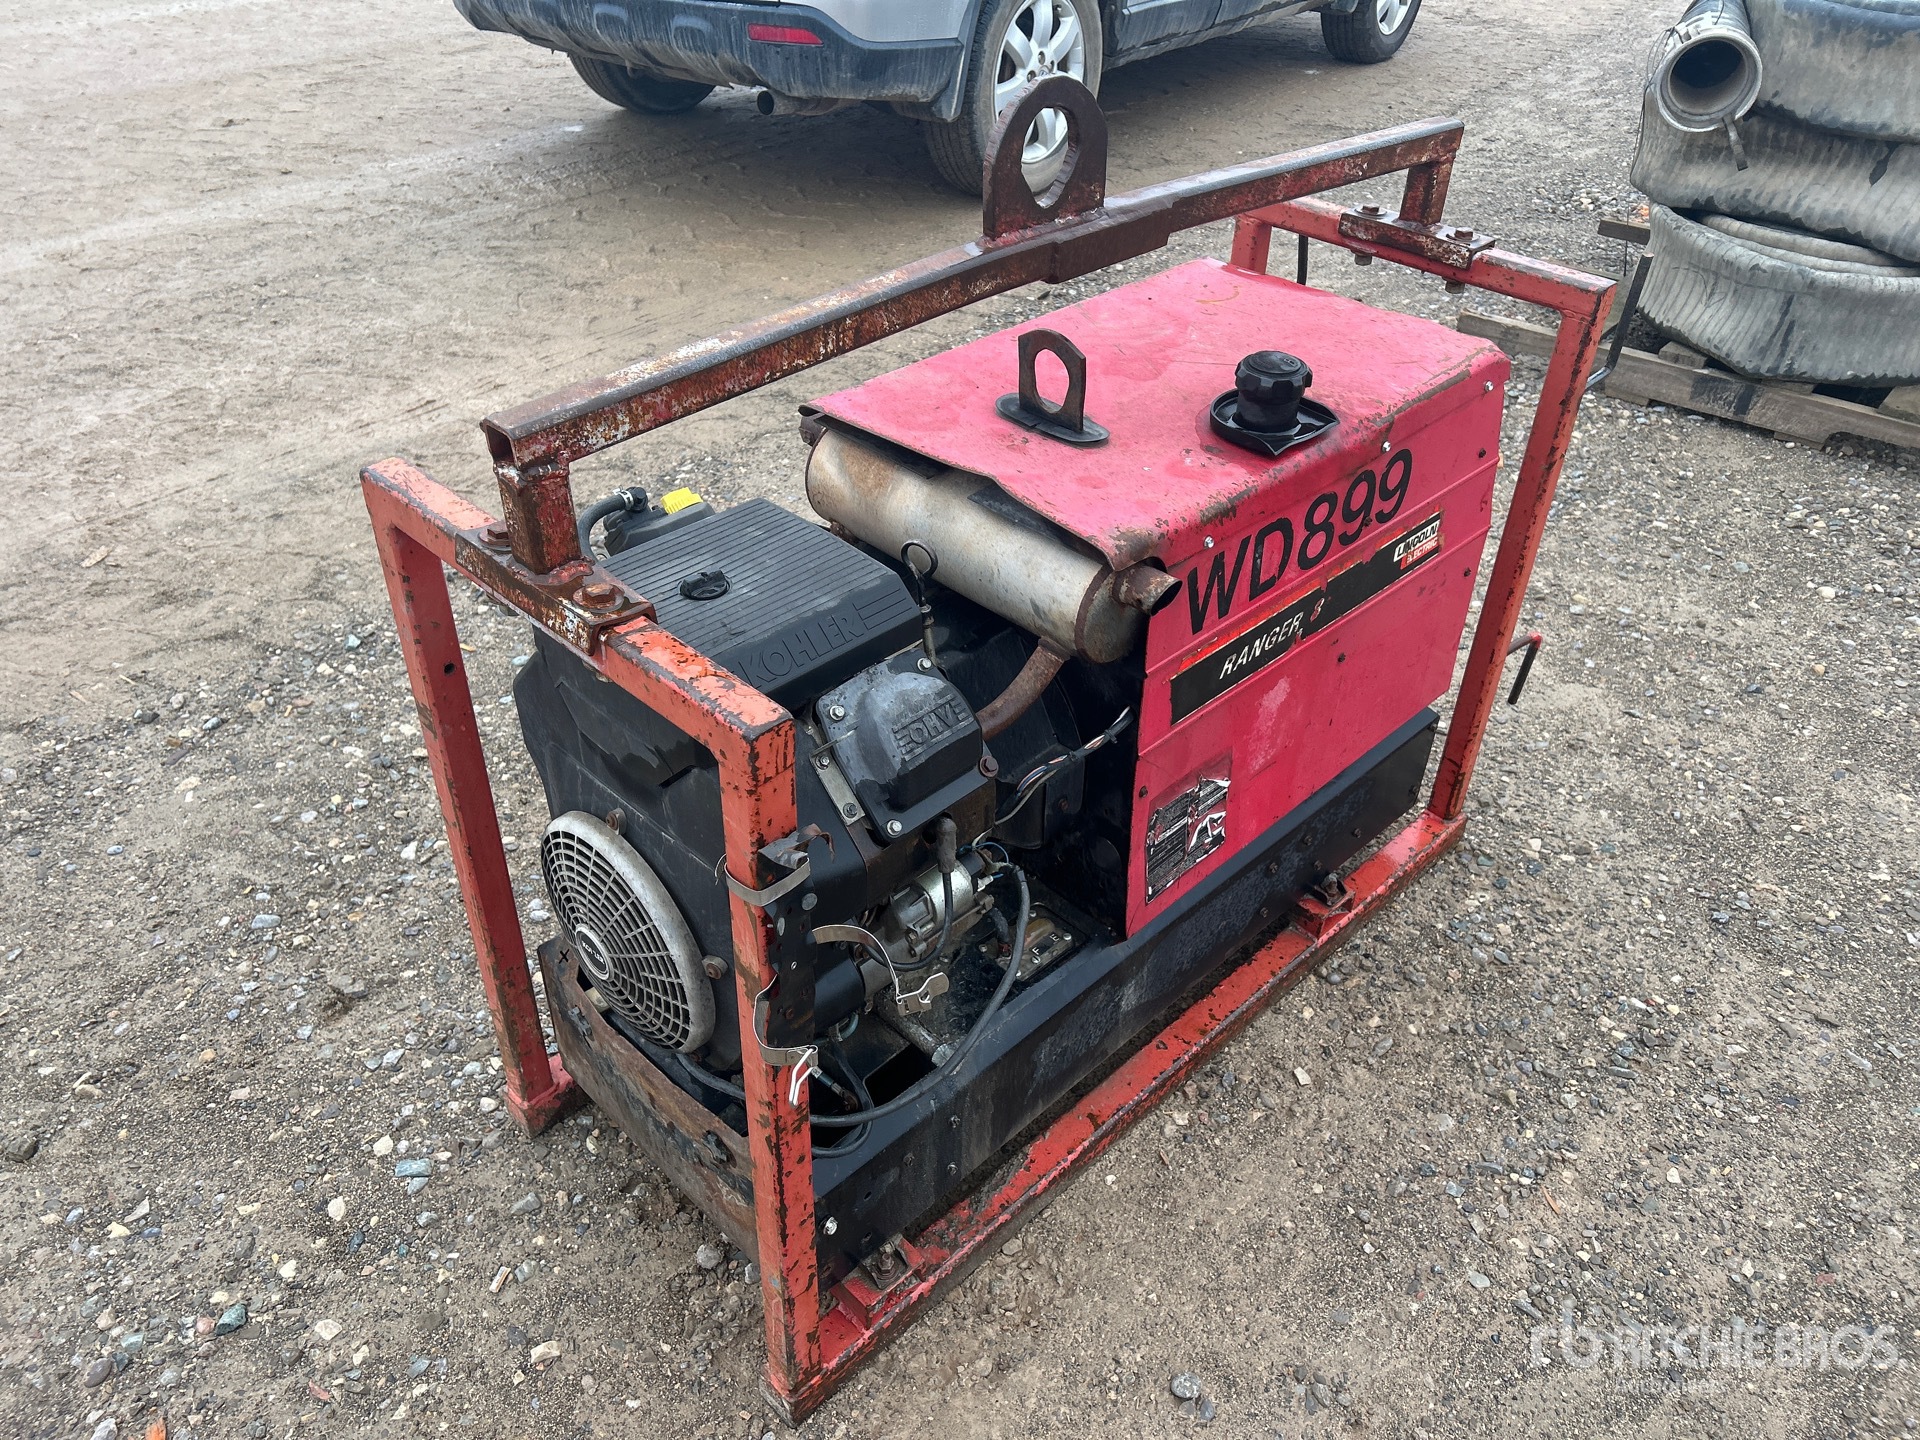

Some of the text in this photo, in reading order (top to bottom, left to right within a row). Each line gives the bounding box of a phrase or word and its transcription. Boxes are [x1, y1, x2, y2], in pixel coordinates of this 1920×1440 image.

[1187, 448, 1413, 635] WD899
[737, 611, 865, 689] KOHLER
[1219, 611, 1304, 680] RANGER
